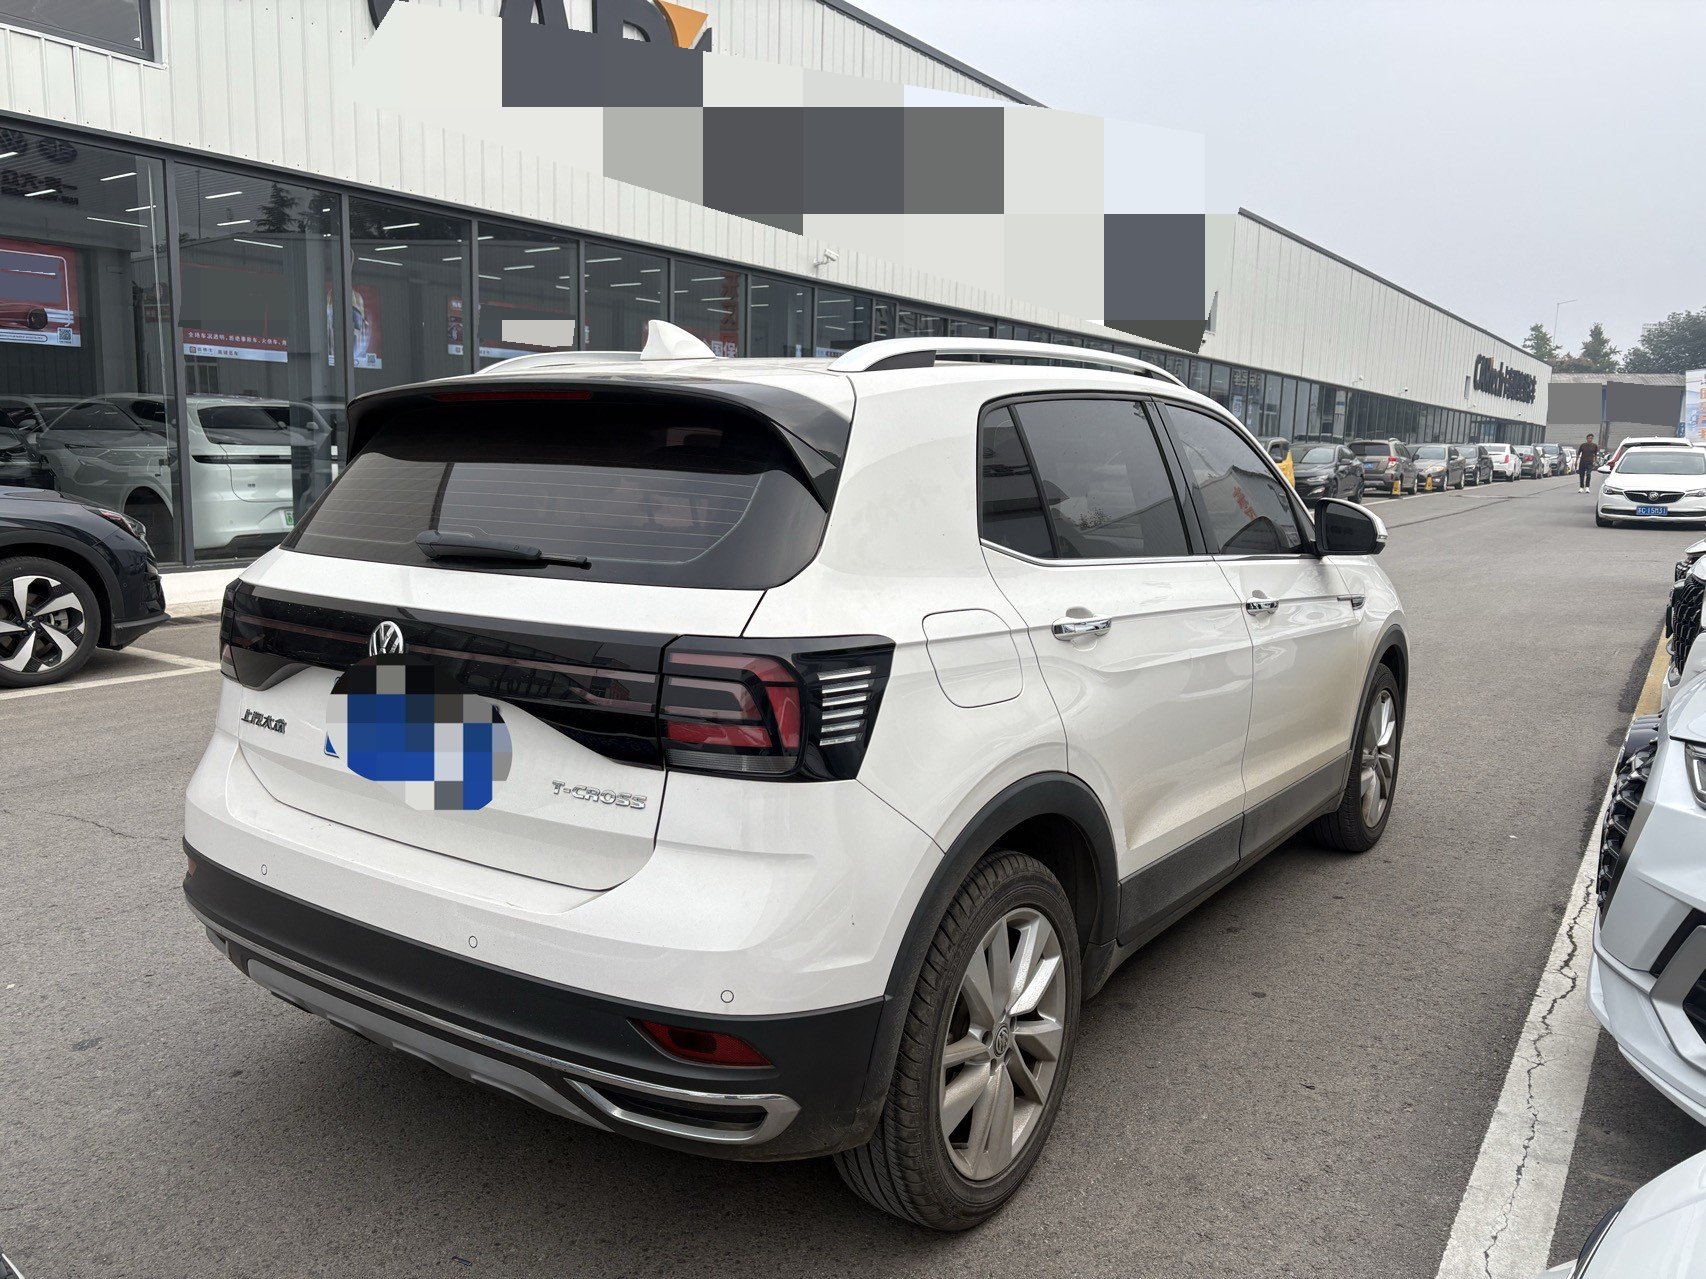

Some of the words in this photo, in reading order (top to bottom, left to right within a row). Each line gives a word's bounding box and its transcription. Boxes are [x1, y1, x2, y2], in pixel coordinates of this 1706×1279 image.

[241, 708, 287, 734] 上汽大众
[552, 779, 647, 809] T-CROSS
